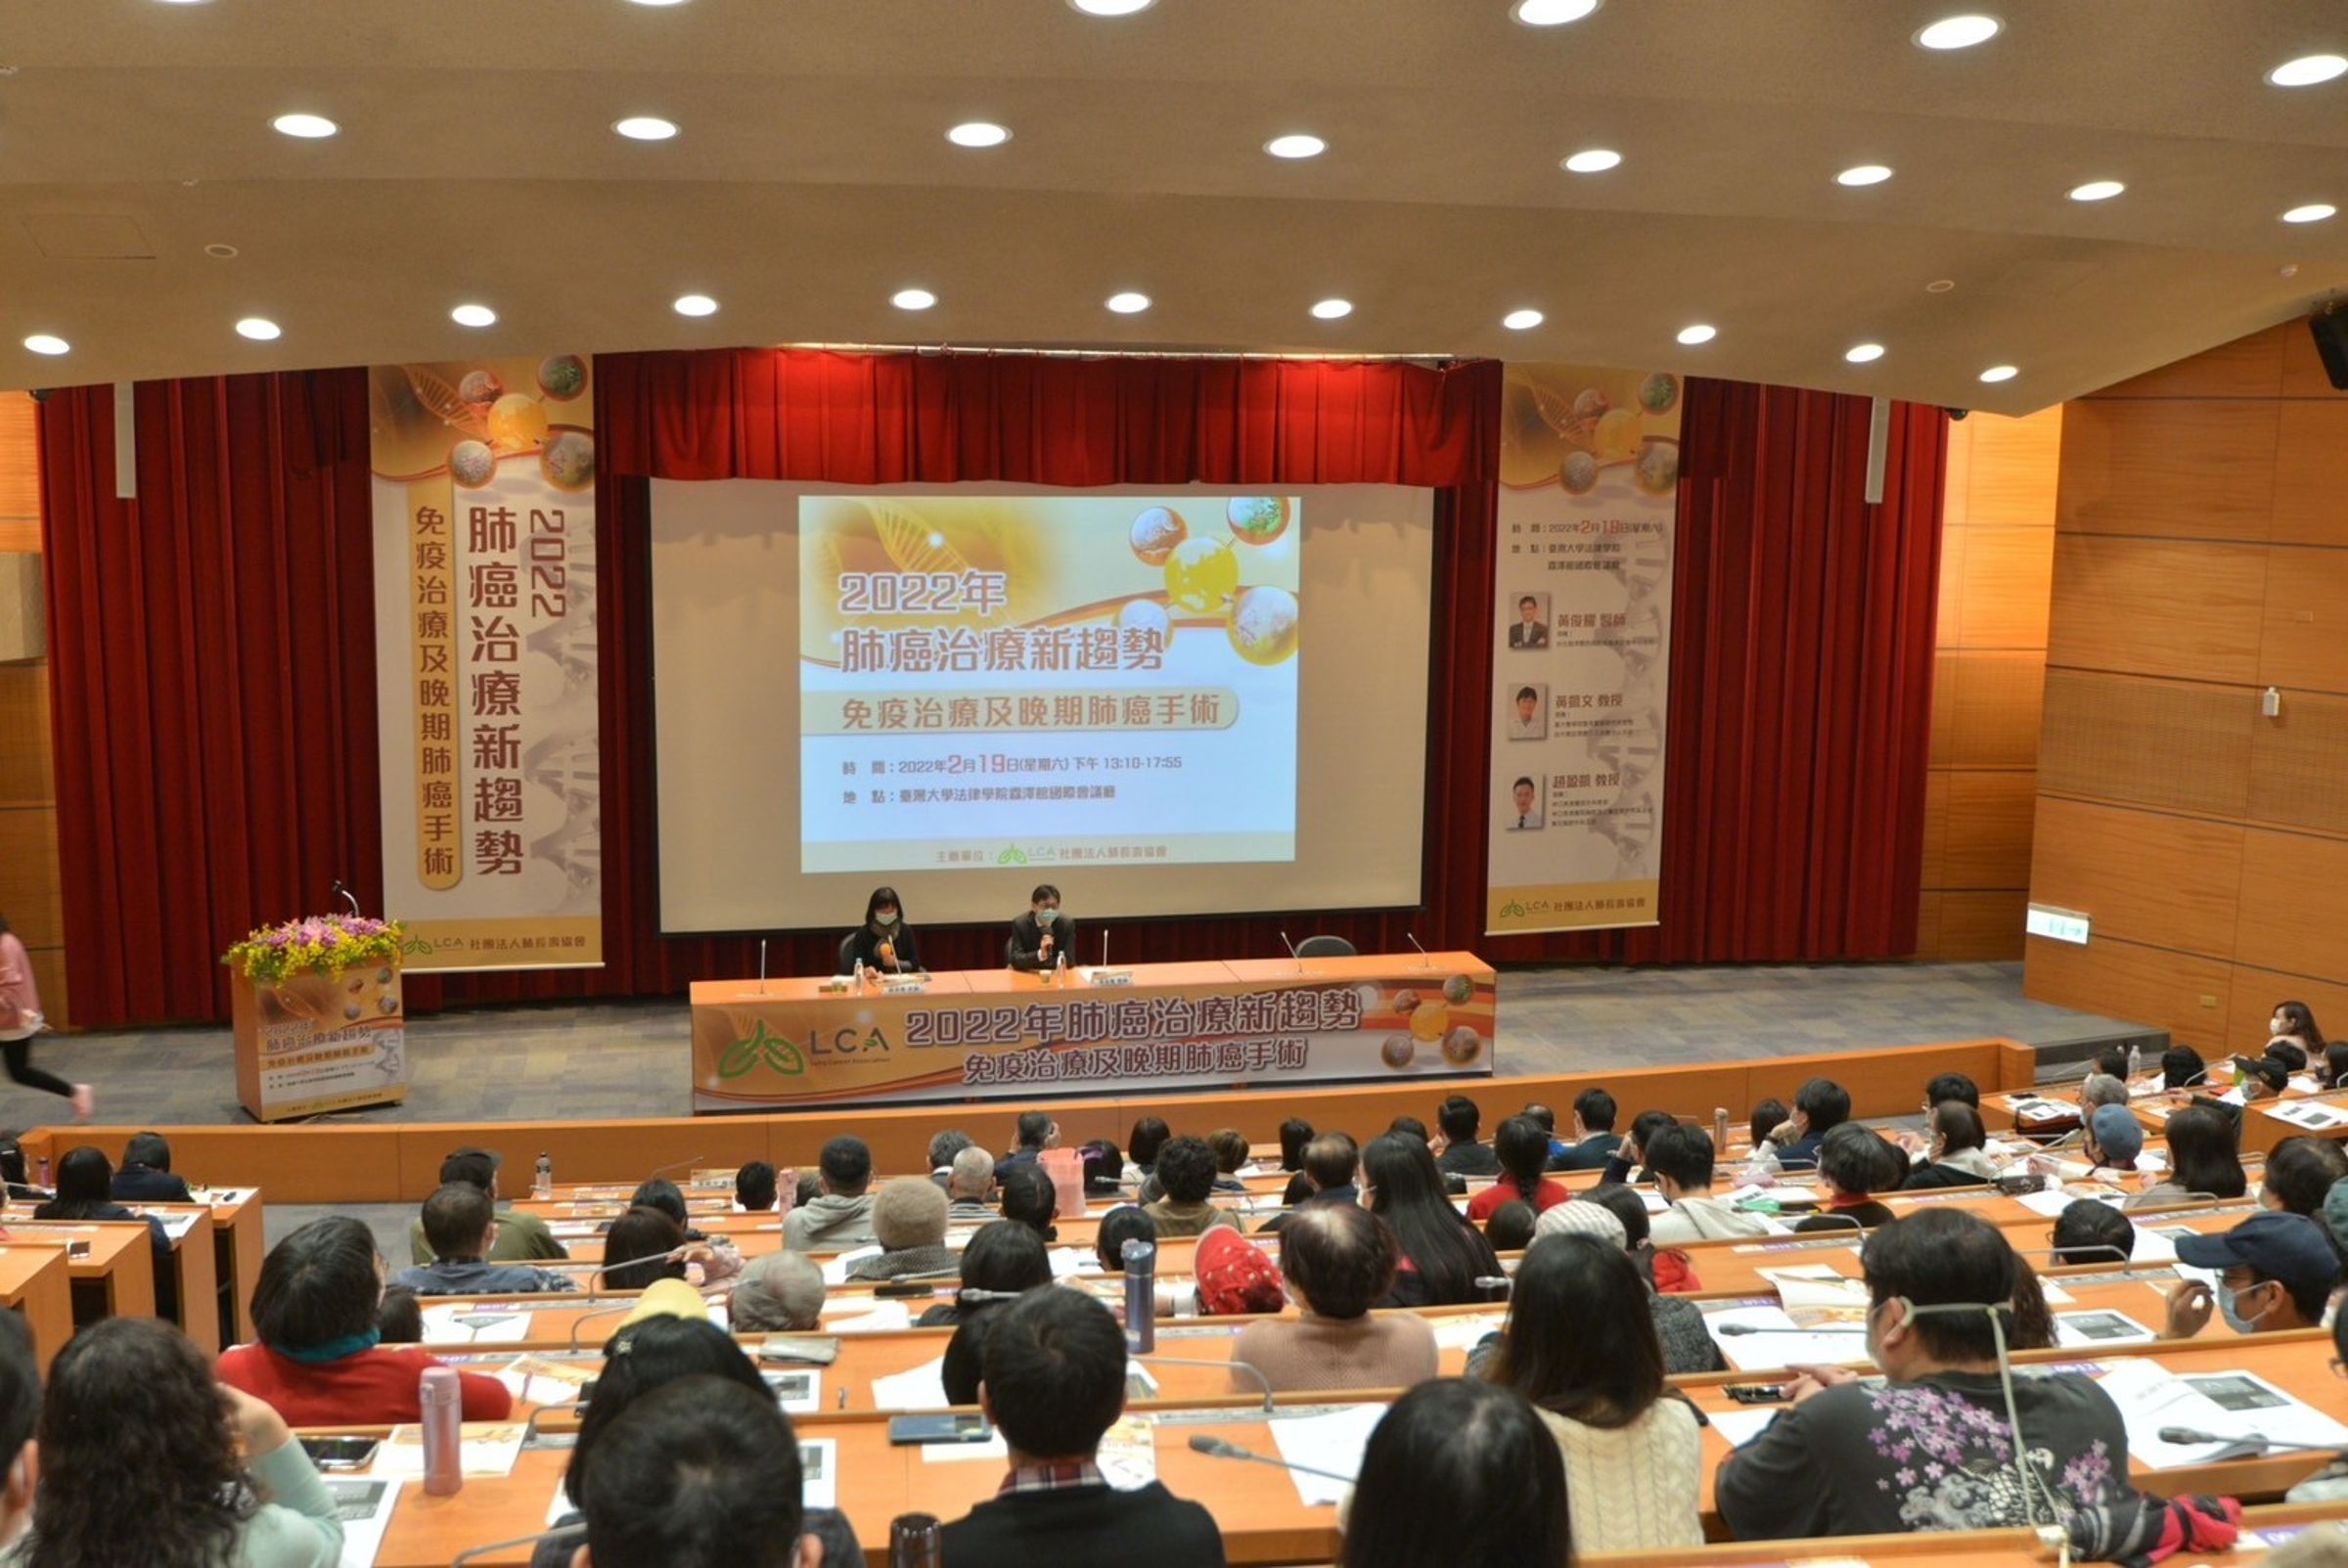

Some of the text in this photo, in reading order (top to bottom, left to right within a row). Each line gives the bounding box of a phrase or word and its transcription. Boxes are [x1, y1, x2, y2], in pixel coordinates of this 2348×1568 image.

[530, 509, 566, 618] 2022
[838, 570, 1006, 614] 2022年
[840, 627, 1164, 673] 肺癌治療新趨勢
[416, 506, 454, 875] 免疫治療及晚期肺癌手術
[470, 506, 524, 875] 肺癌治療新趨勢
[841, 694, 1220, 730] 免疫治療及晚期肺癌手術
[1525, 899, 1550, 912] LCA
[433, 936, 464, 949] LCA
[810, 1027, 890, 1055] LCA
[905, 989, 1362, 1047] 2022年肺癌治療新趨勢
[962, 1036, 1309, 1085] 免疫治療及晚期肺癌手術
